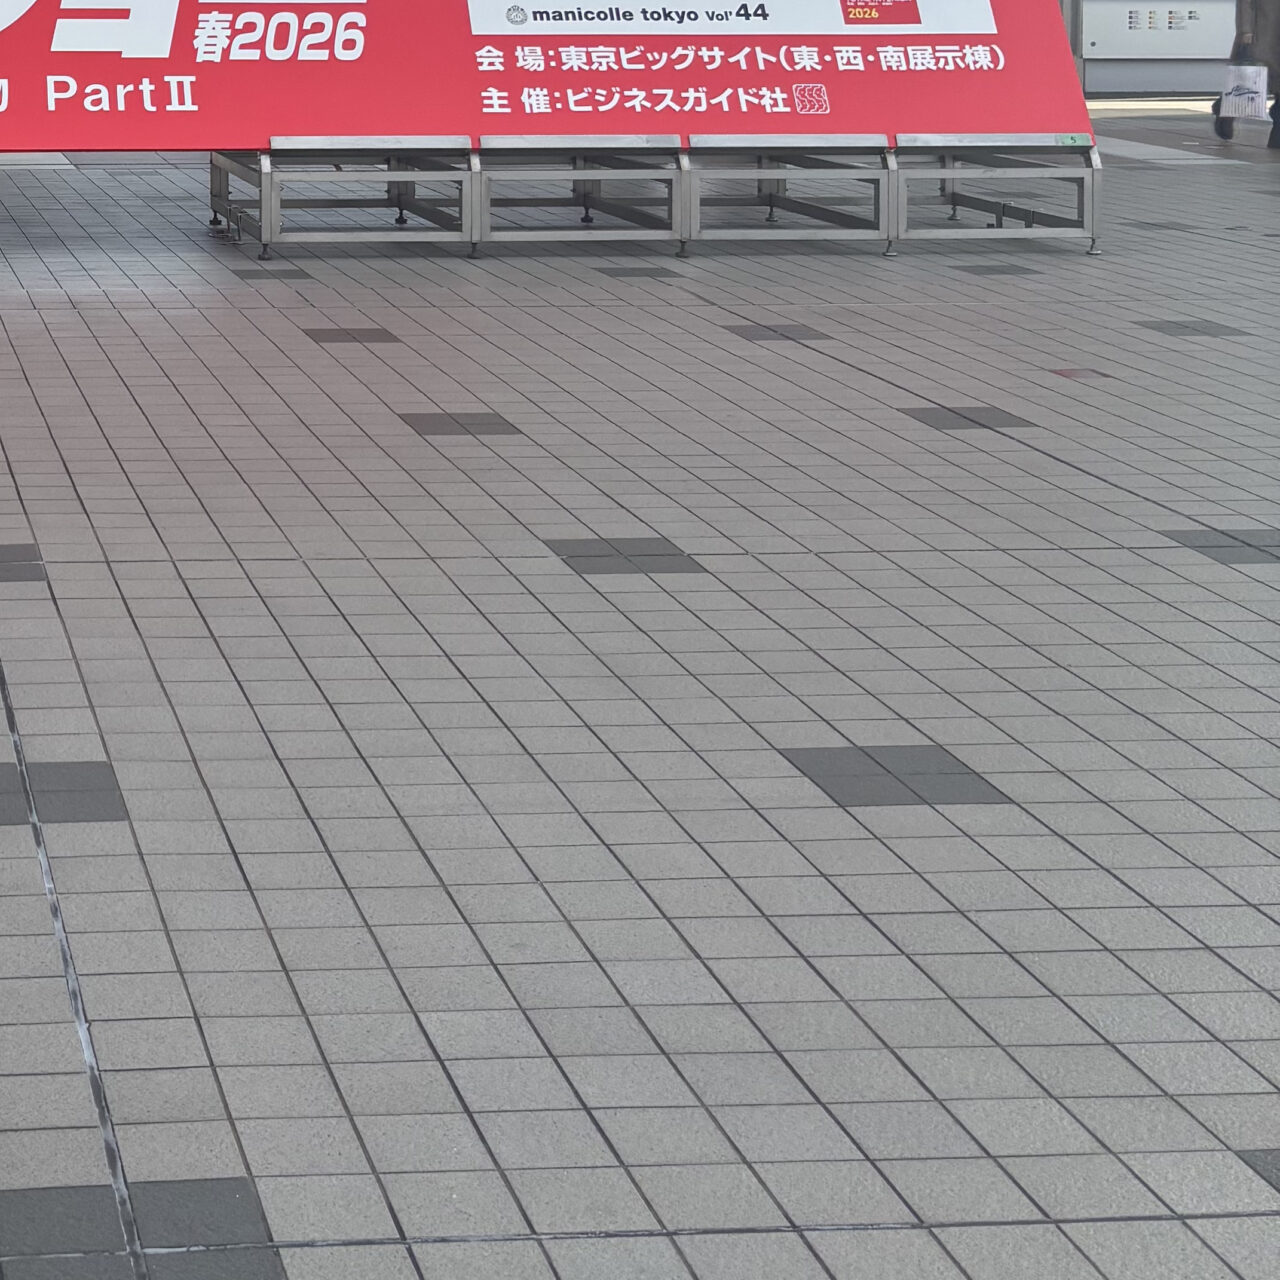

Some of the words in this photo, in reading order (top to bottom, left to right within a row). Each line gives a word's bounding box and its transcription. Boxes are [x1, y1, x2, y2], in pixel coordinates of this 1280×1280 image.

[532, 6, 634, 22] manicolle
[641, 6, 699, 25] tokyo
[847, 8, 880, 19] 2026
[193, 10, 367, 63] 春2026
[1070, 136, 1077, 144] 5
